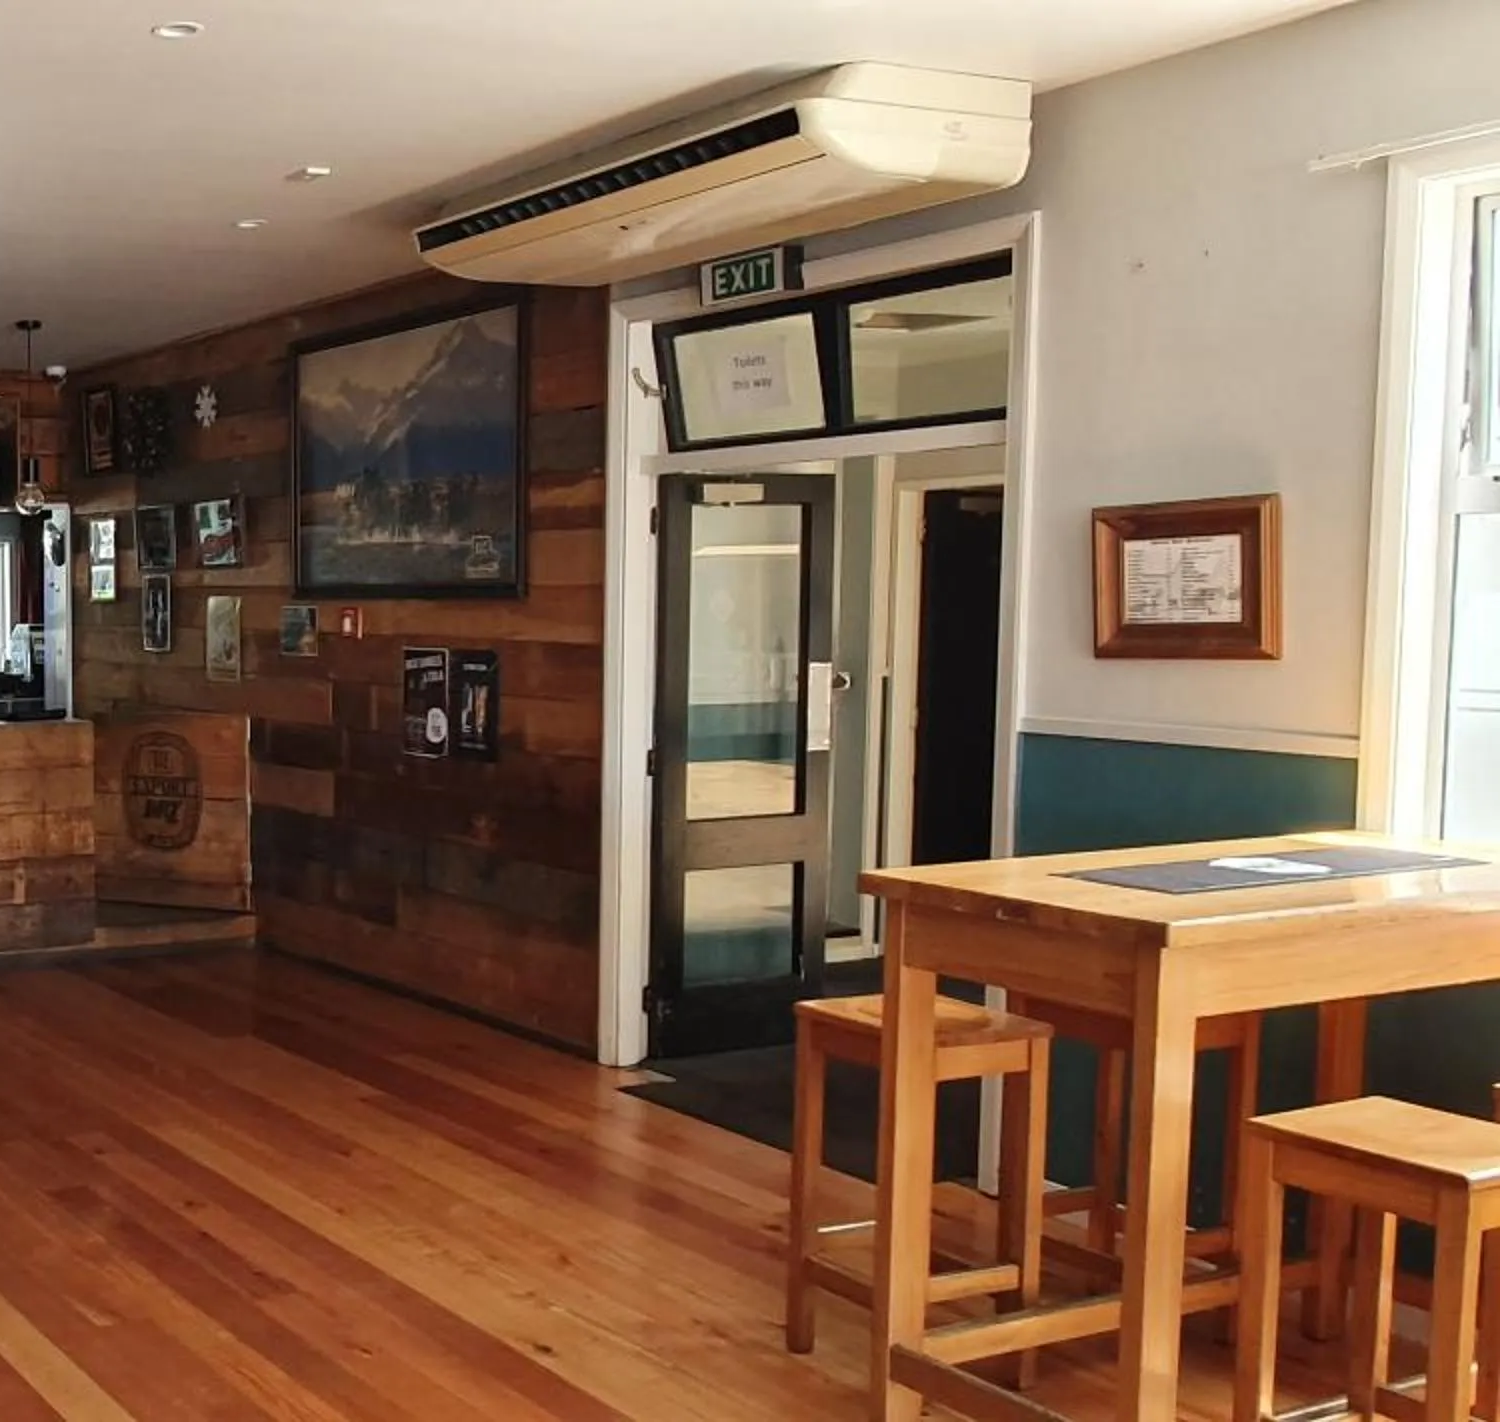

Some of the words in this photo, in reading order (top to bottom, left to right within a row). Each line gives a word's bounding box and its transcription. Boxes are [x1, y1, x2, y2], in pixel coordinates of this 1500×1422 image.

[715, 257, 771, 296] EXIT
[732, 354, 766, 368] Toilets
[753, 377, 773, 389] way
